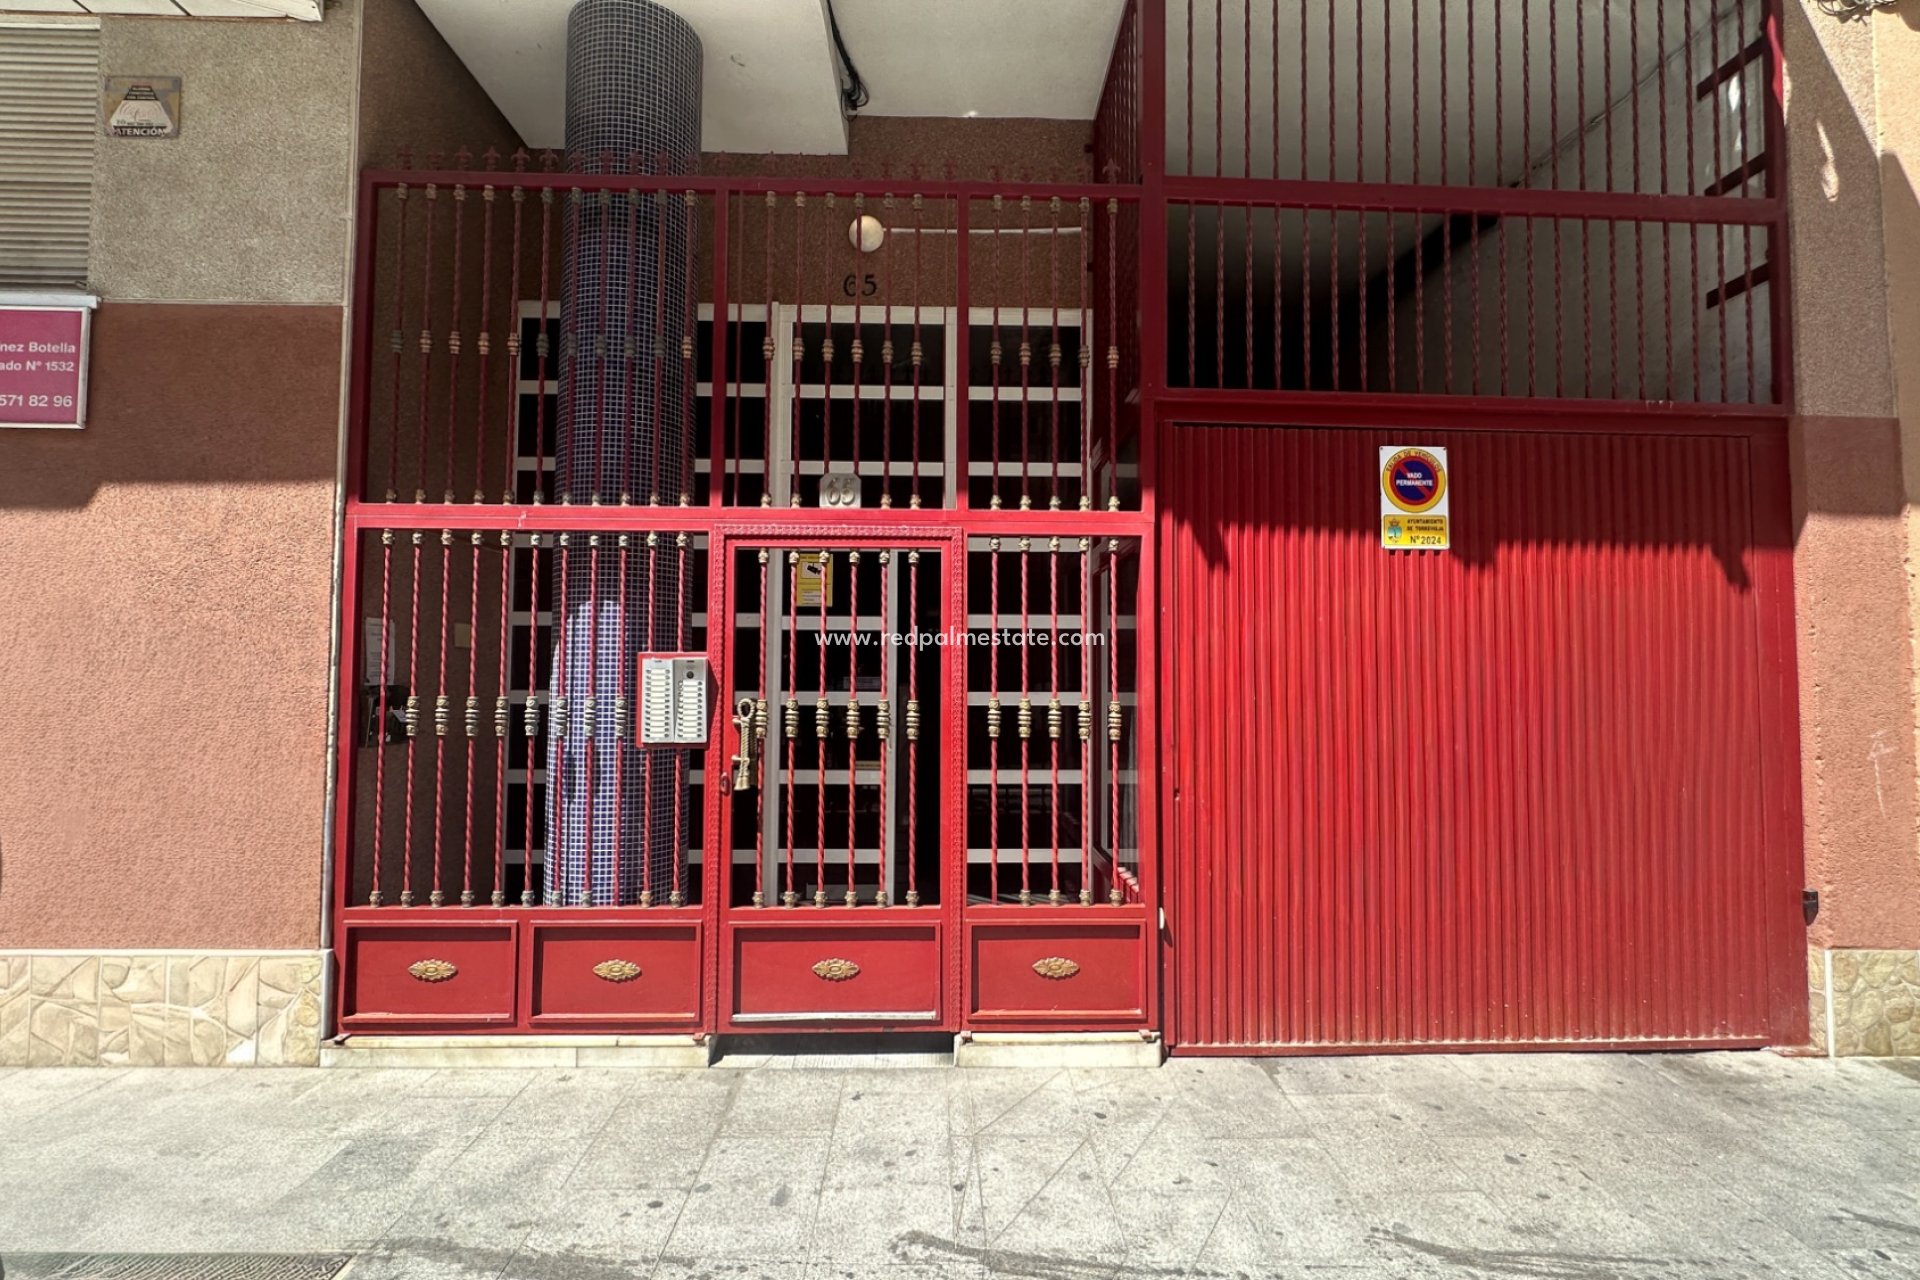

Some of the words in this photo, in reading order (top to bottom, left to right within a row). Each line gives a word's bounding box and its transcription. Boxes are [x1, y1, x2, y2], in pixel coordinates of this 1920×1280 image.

[843, 274, 877, 297] 65
[28, 342, 76, 353] Botella
[46, 361, 74, 371] 1532
[28, 395, 48, 407] 82
[53, 395, 73, 407] 96
[826, 477, 855, 506] 65
[1421, 535, 1442, 545] 2024
